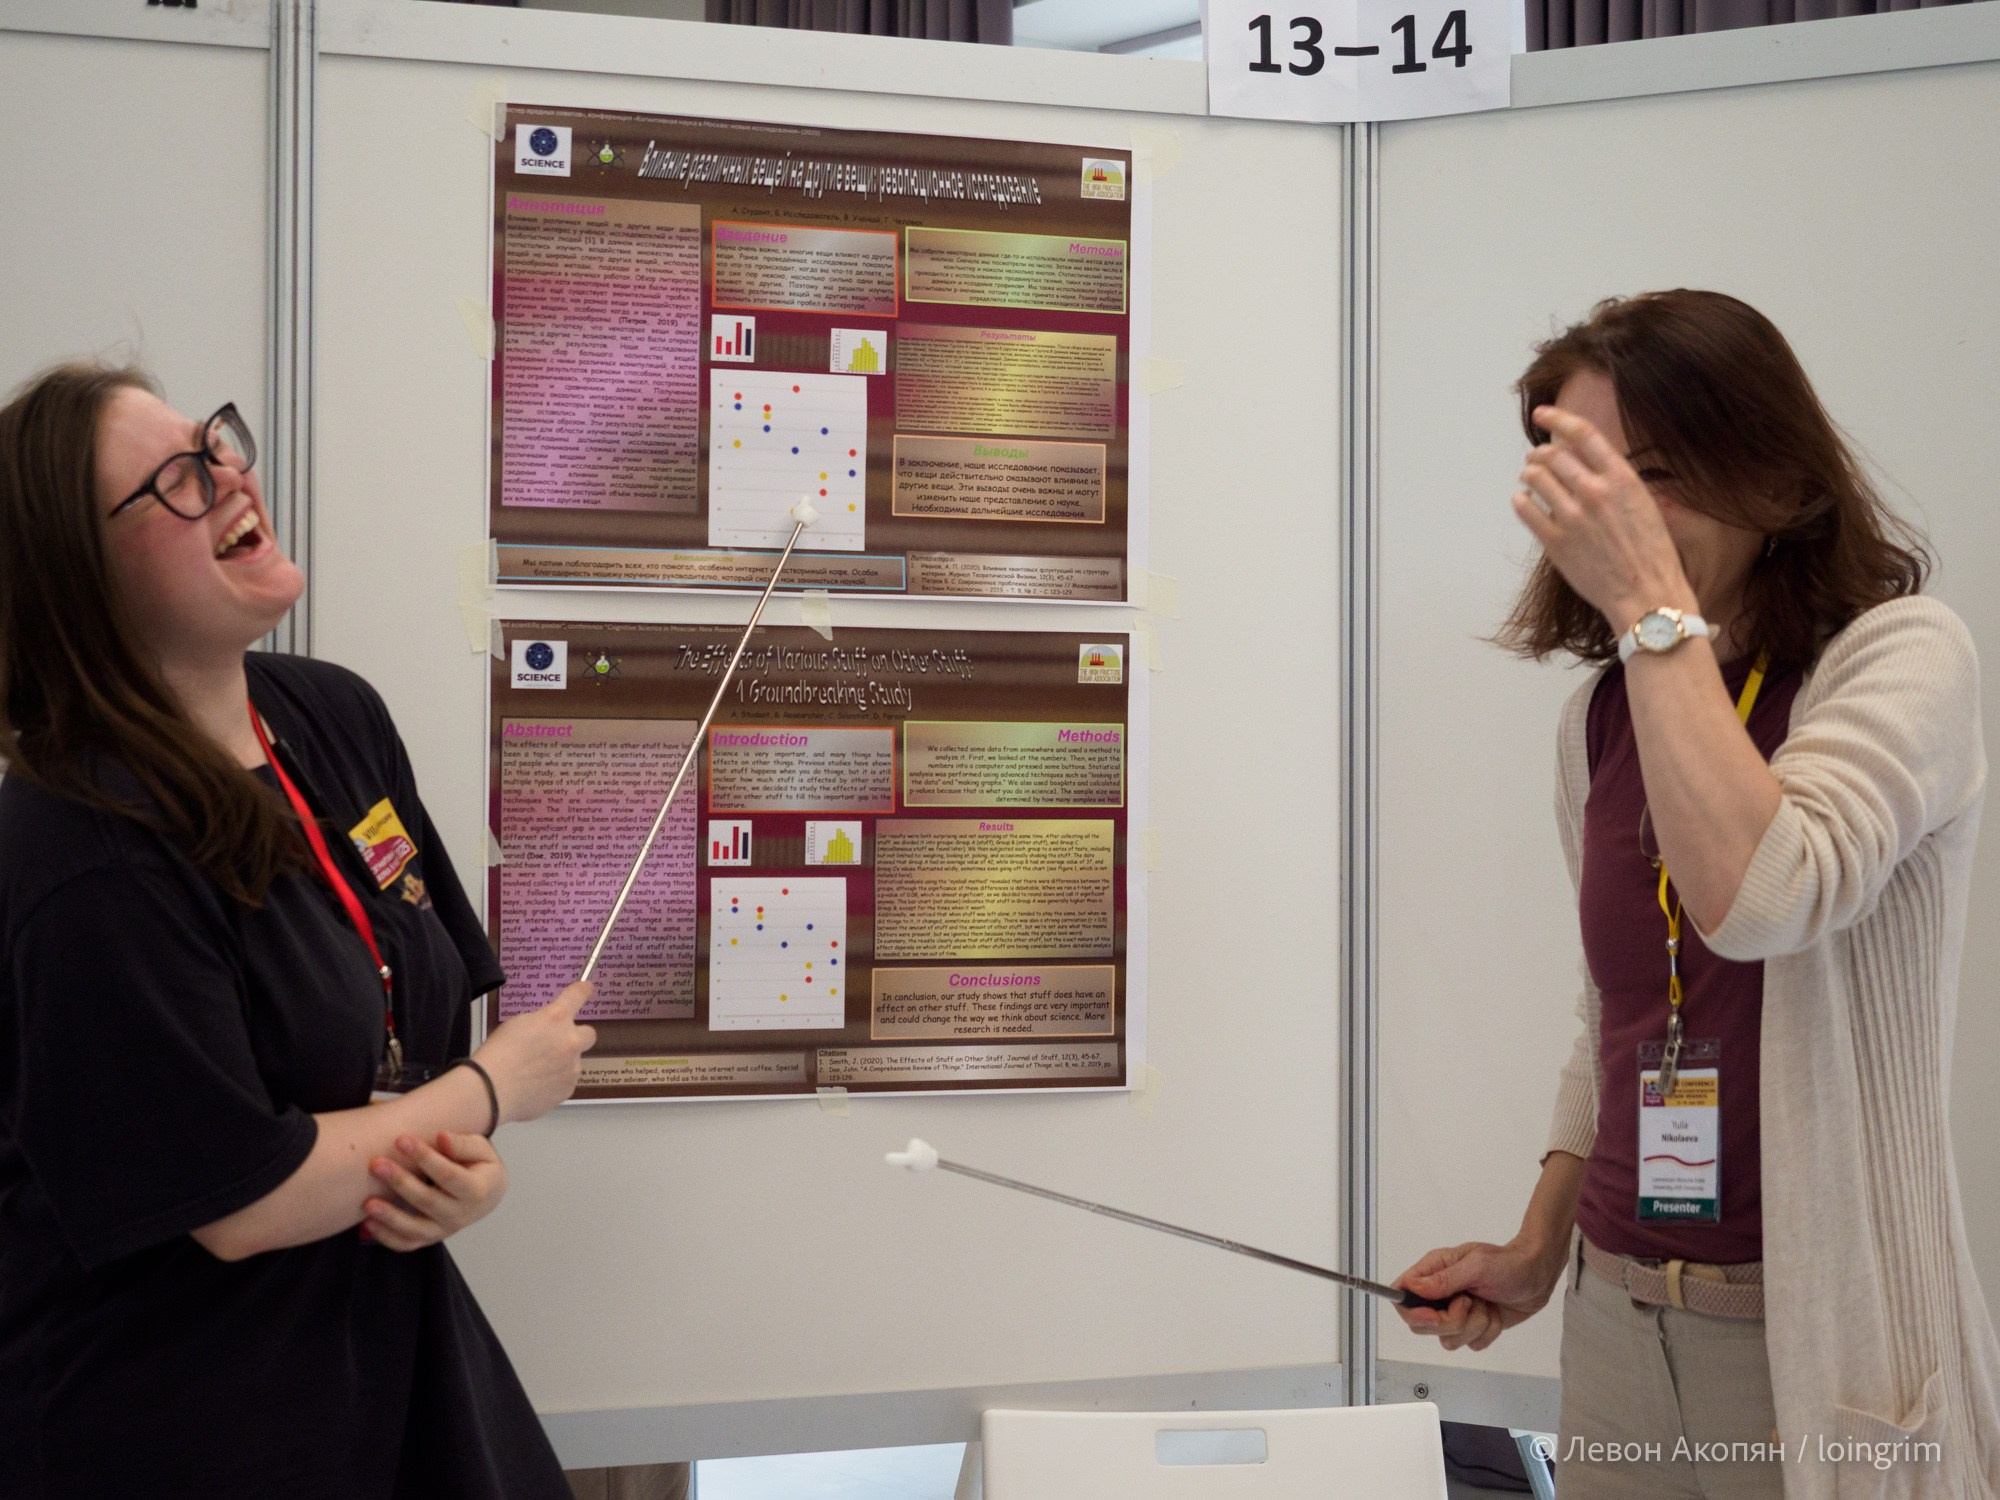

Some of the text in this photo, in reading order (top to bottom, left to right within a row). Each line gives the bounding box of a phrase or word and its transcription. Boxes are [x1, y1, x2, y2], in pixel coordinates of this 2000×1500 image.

[1249, 9, 1472, 76] 13–14
[521, 158, 565, 169] SCIENCE
[637, 140, 691, 180] Влияние
[684, 153, 753, 190] различных
[751, 151, 790, 194] вещей
[790, 160, 804, 188] на
[803, 162, 843, 199] другие
[845, 164, 877, 200] вещи:
[879, 167, 964, 204] революционное
[965, 172, 1041, 211] исследование
[1068, 243, 1123, 257] Методы
[980, 331, 1036, 342] Результаты
[972, 445, 1029, 460] Выводы
[898, 456, 905, 466] В
[907, 460, 962, 470] заключение,
[987, 463, 1047, 473] исследование
[1049, 466, 1099, 476] показывает,
[914, 472, 937, 481] вещи
[939, 470, 1004, 483] действительно
[1005, 475, 1051, 483] оказывают
[898, 482, 928, 492] другие
[958, 482, 974, 492] Эти
[975, 485, 1009, 494] выводы
[1074, 489, 1098, 499] могут
[916, 494, 957, 502] изменить
[983, 497, 1047, 508] представление
[1056, 500, 1081, 509] науке.
[911, 502, 1086, 520] Необходимы дальнейшие исследования.
[674, 644, 699, 669] The
[756, 645, 773, 676] of
[777, 646, 828, 670] Various
[832, 647, 867, 677] Stuff
[872, 654, 890, 672] on
[892, 648, 930, 672] Other
[932, 649, 974, 679] Stuff:
[517, 674, 561, 682] SCIENCE
[750, 679, 867, 711] Groundbreaking
[869, 681, 912, 711] Study
[502, 723, 572, 737] Abstract
[1057, 729, 1120, 743] Methods
[712, 732, 808, 746] Introduction
[774, 750, 808, 759] important,
[851, 750, 871, 760] things
[979, 822, 1014, 832] Results
[948, 973, 1042, 987] Conclusions
[881, 992, 892, 1001] In
[894, 991, 938, 1002] conclusion,
[956, 990, 980, 1002] study
[982, 990, 1007, 1000] shows
[1009, 990, 1027, 999] that
[1029, 989, 1051, 999] stuff
[1053, 989, 1072, 999] does
[1074, 989, 1093, 998] have
[876, 1002, 904, 1012] effect
[918, 1001, 942, 1011] other
[944, 1001, 968, 1011] stuff.
[971, 1000, 996, 1010] These
[999, 1000, 1032, 1012] findings
[1049, 1002, 1068, 1012] very
[1070, 999, 1109, 1011] important
[879, 1014, 896, 1023] and
[897, 1013, 920, 1023] could
[922, 1013, 951, 1025] change
[953, 1012, 967, 1022] the
[969, 1015, 985, 1024] way
[1000, 1012, 1022, 1021] think
[1024, 1011, 1047, 1021] about
[1049, 1011, 1081, 1021] science.
[1084, 1010, 1105, 1020] More
[953, 1023, 1033, 1033] research is needed.
[1661, 1134, 1698, 1142] Nikolaeva
[1652, 1200, 1701, 1214] Presenter
